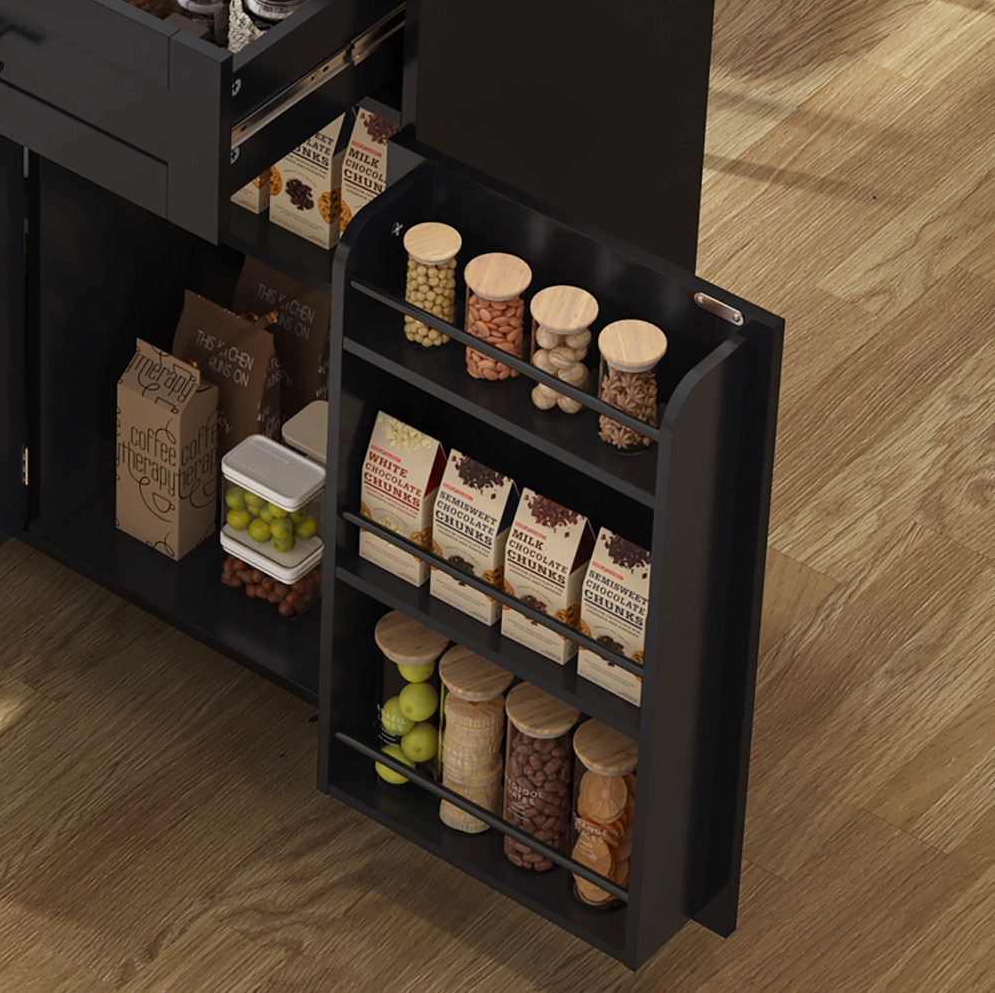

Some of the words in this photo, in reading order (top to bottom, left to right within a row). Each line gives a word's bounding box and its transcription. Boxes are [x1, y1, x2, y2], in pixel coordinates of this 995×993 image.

[345, 158, 386, 183] CHOCOL
[348, 147, 380, 168] MILK
[344, 168, 384, 193] CHUN
[196, 329, 216, 351] THIS
[233, 369, 250, 387] ON
[131, 420, 176, 467] coffee
[118, 441, 175, 497] therapy
[365, 462, 422, 497] CHOCOLATE
[369, 451, 408, 478] WHITE
[364, 471, 420, 507] CHUNKS
[437, 500, 494, 535] CHOCOLATE
[439, 491, 497, 525] SEMISWEET
[435, 510, 492, 546] CHUNKS
[512, 528, 544, 551] MILK
[507, 549, 566, 585] CHUNKS
[509, 539, 568, 574] CHOCOLATE
[586, 579, 646, 616] CHOCOLATE
[588, 570, 649, 606] SEMISWEET
[584, 589, 643, 626] CHUNKS
